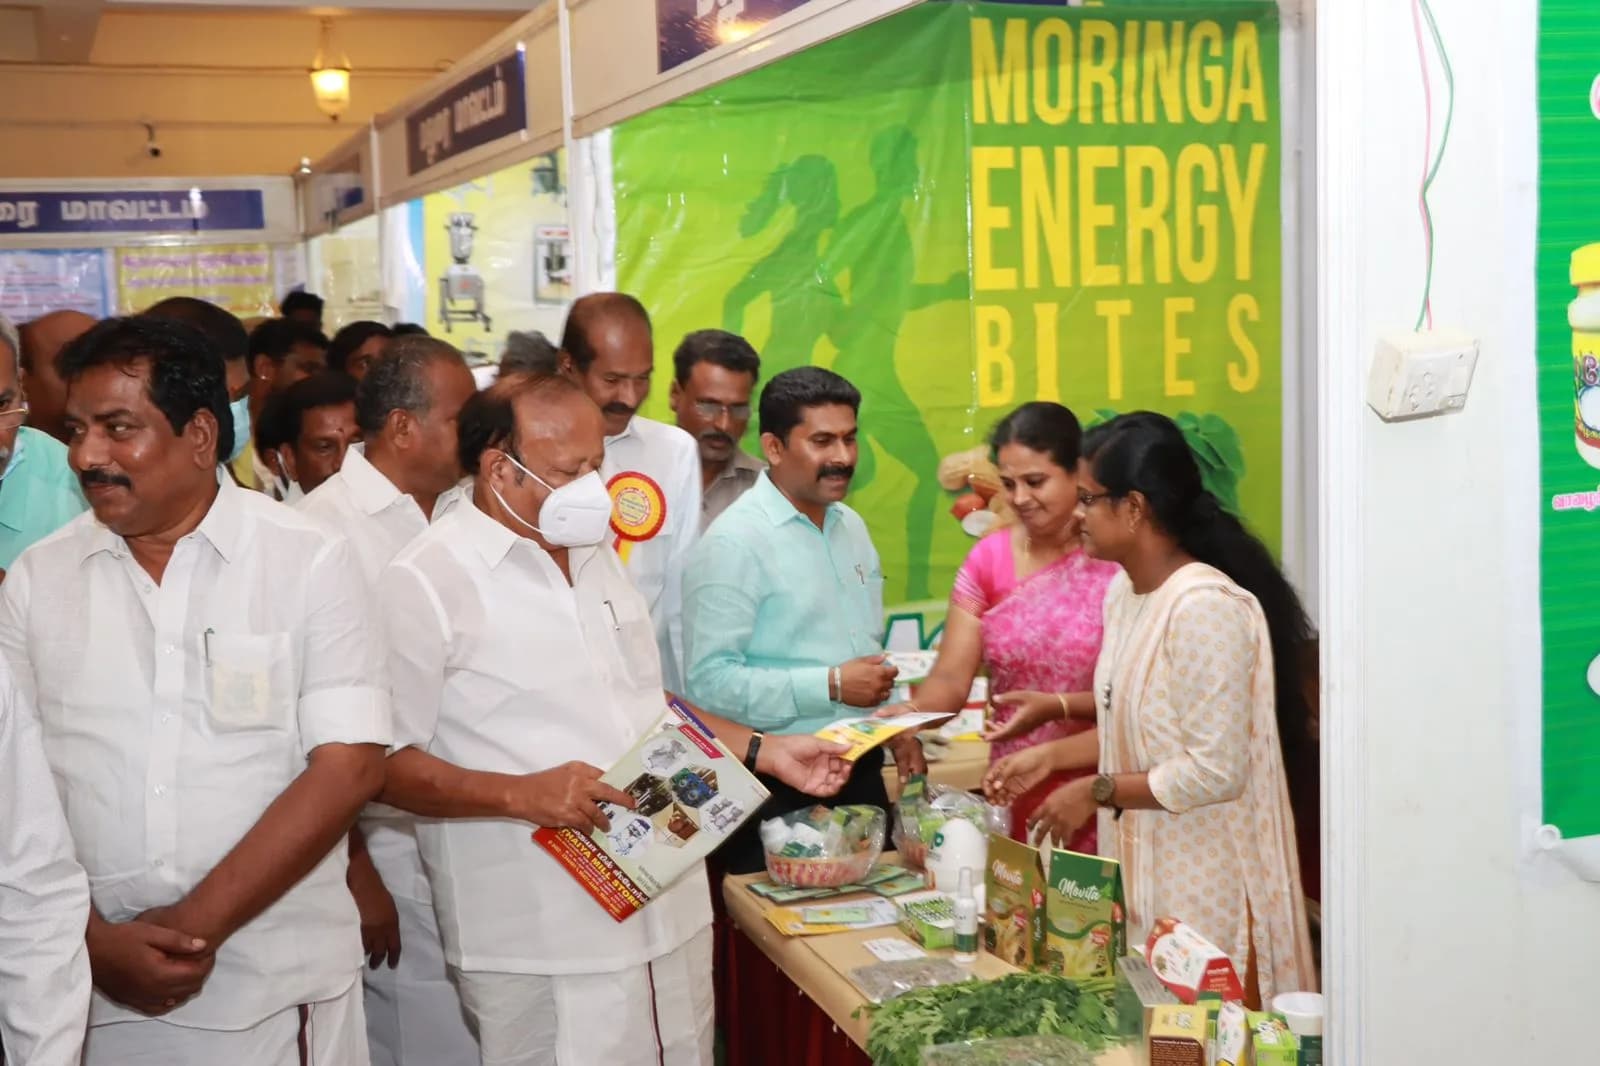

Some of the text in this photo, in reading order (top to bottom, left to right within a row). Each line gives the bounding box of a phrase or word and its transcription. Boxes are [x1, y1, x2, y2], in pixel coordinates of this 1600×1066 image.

[970, 17, 1267, 125] MORINGA
[972, 143, 1267, 291] ENERGY
[975, 293, 1260, 408] BITES
[591, 857, 611, 881] MILL
[1058, 878, 1102, 903] Movita
